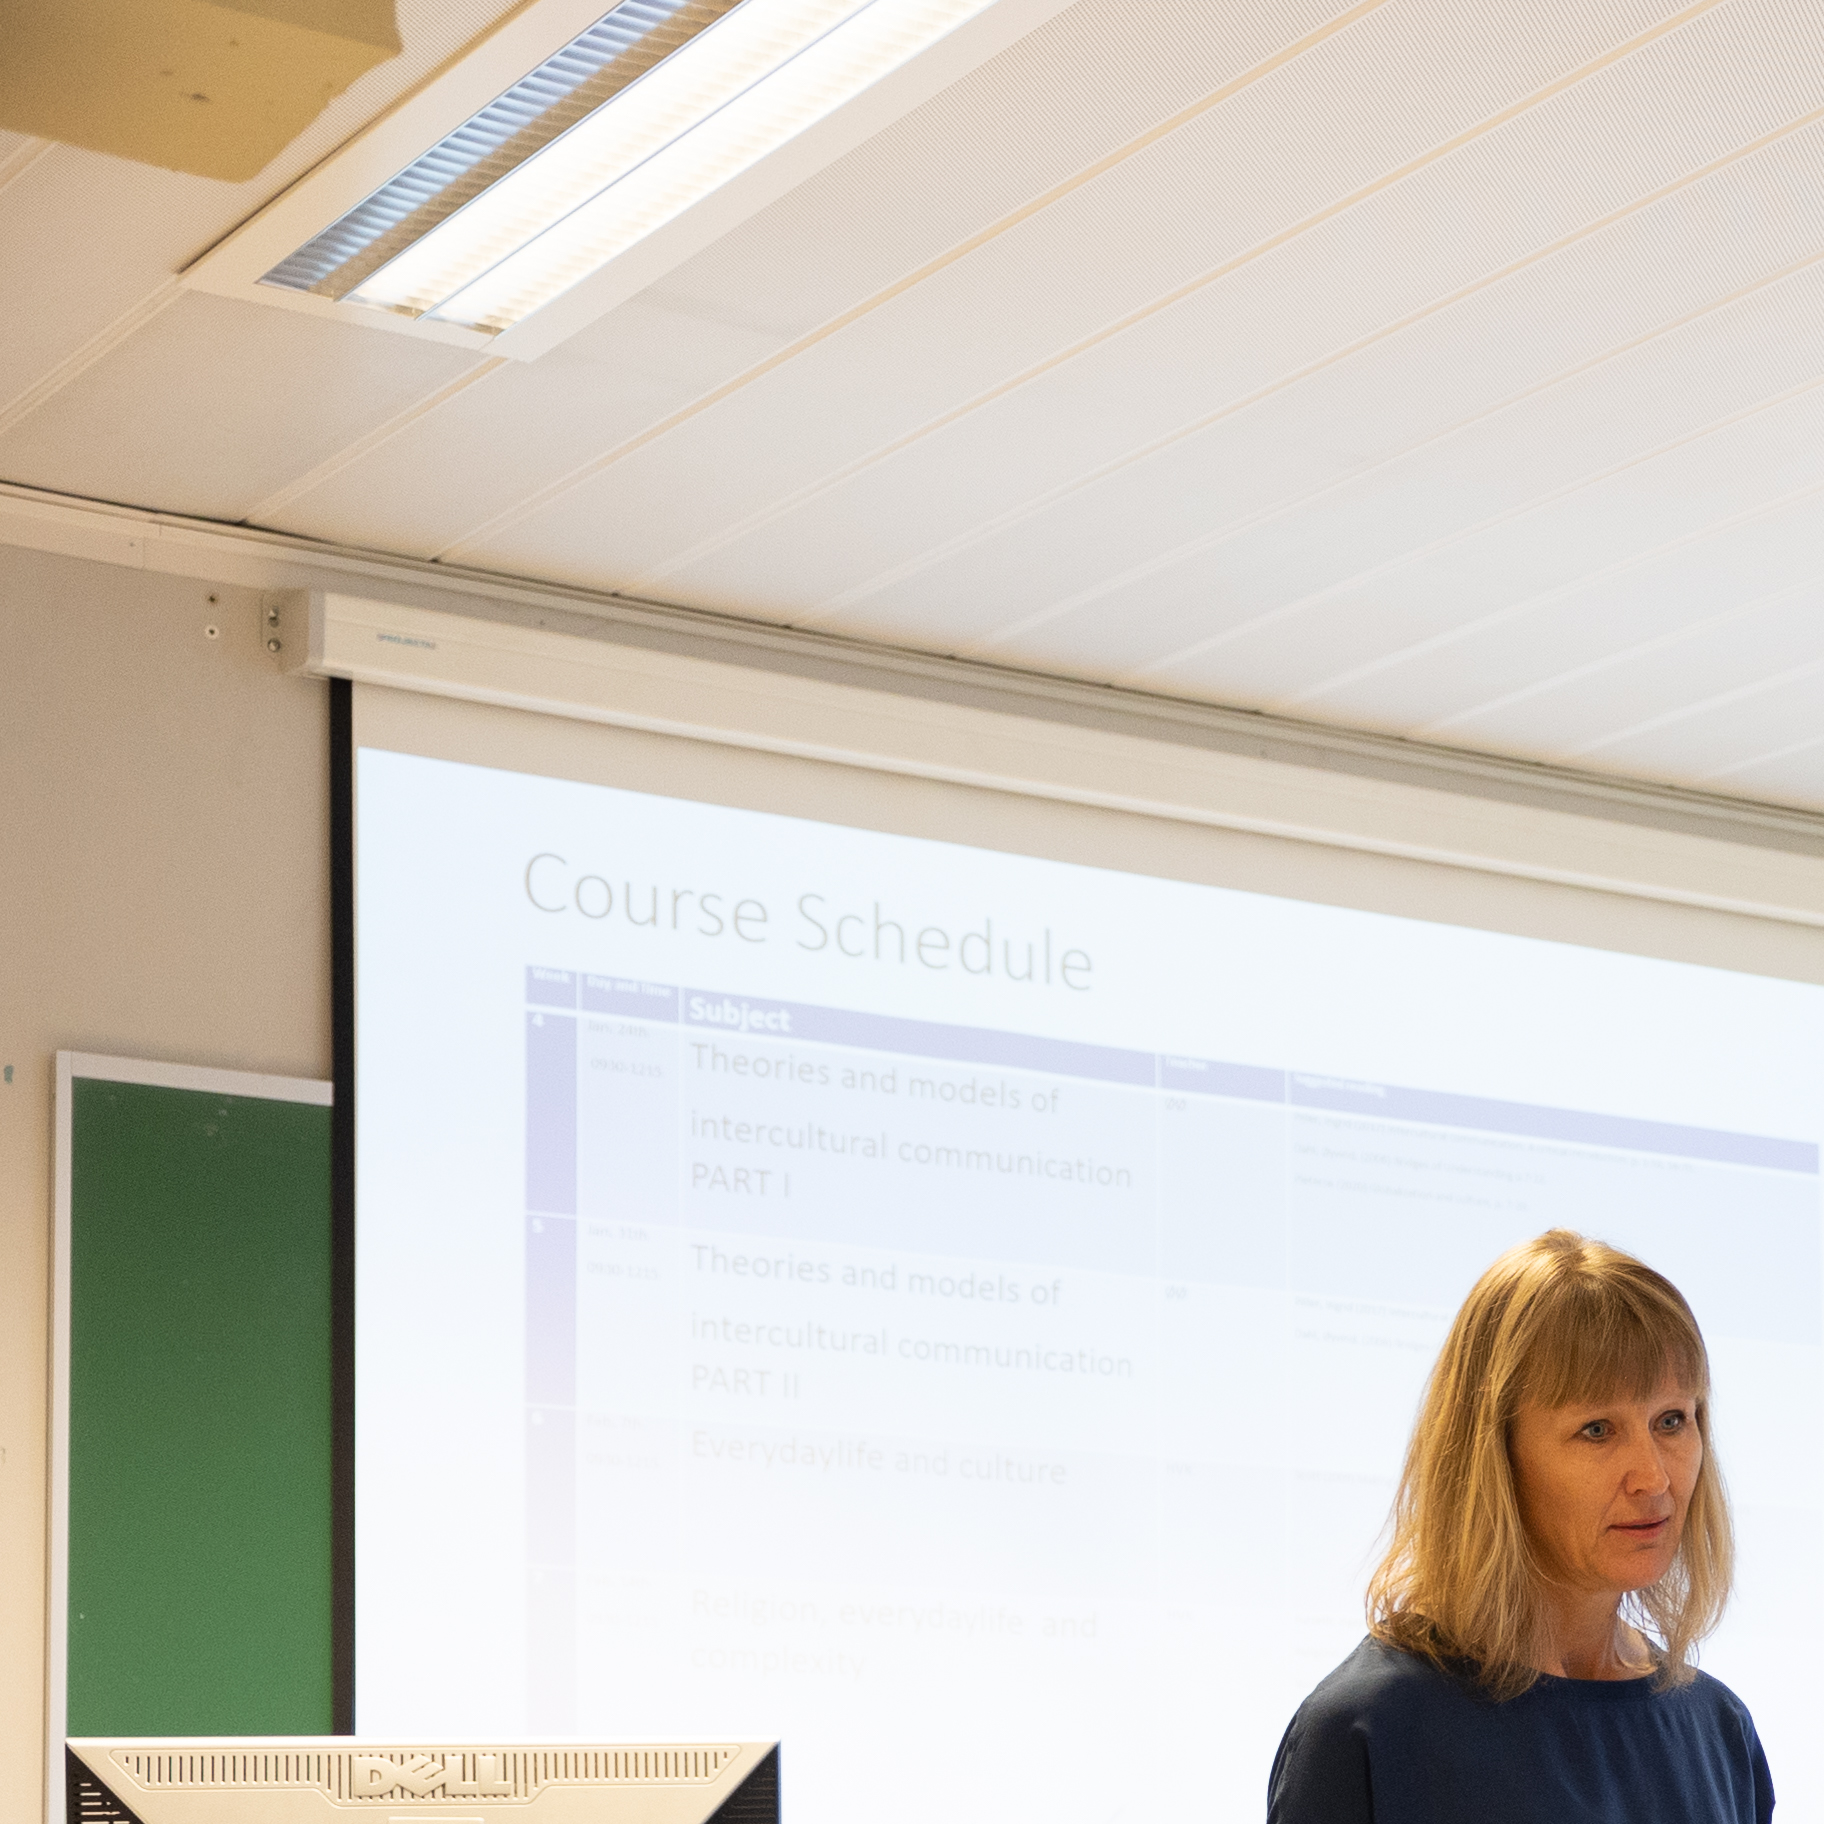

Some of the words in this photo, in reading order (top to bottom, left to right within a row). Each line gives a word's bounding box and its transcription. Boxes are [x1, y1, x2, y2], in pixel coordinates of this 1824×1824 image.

[523, 850, 770, 946] Course
[795, 892, 1096, 994] Schedule
[688, 996, 793, 1033] Subject
[690, 1042, 831, 1088] Theories
[841, 1061, 899, 1096] and
[909, 1067, 1022, 1112] models
[1031, 1080, 1061, 1115] of
[690, 1111, 888, 1163] intercultural
[897, 1138, 1133, 1190] communication
[691, 1163, 773, 1198] PART
[690, 1243, 831, 1287] Theories
[841, 1260, 899, 1293] and
[908, 1267, 1022, 1306] models
[1030, 1277, 1063, 1308] of
[690, 1312, 888, 1359] intercultural
[897, 1334, 1135, 1380] communication
[691, 1365, 772, 1398] PART
[782, 1373, 802, 1400] II
[690, 1430, 885, 1474] Everydaylife
[893, 1442, 950, 1478] and
[959, 1448, 1068, 1487] culture
[690, 1588, 829, 1630] Religion,
[838, 1600, 1024, 1638] everydaylife
[1041, 1609, 1099, 1641] and
[352, 1754, 513, 1798] DELL
